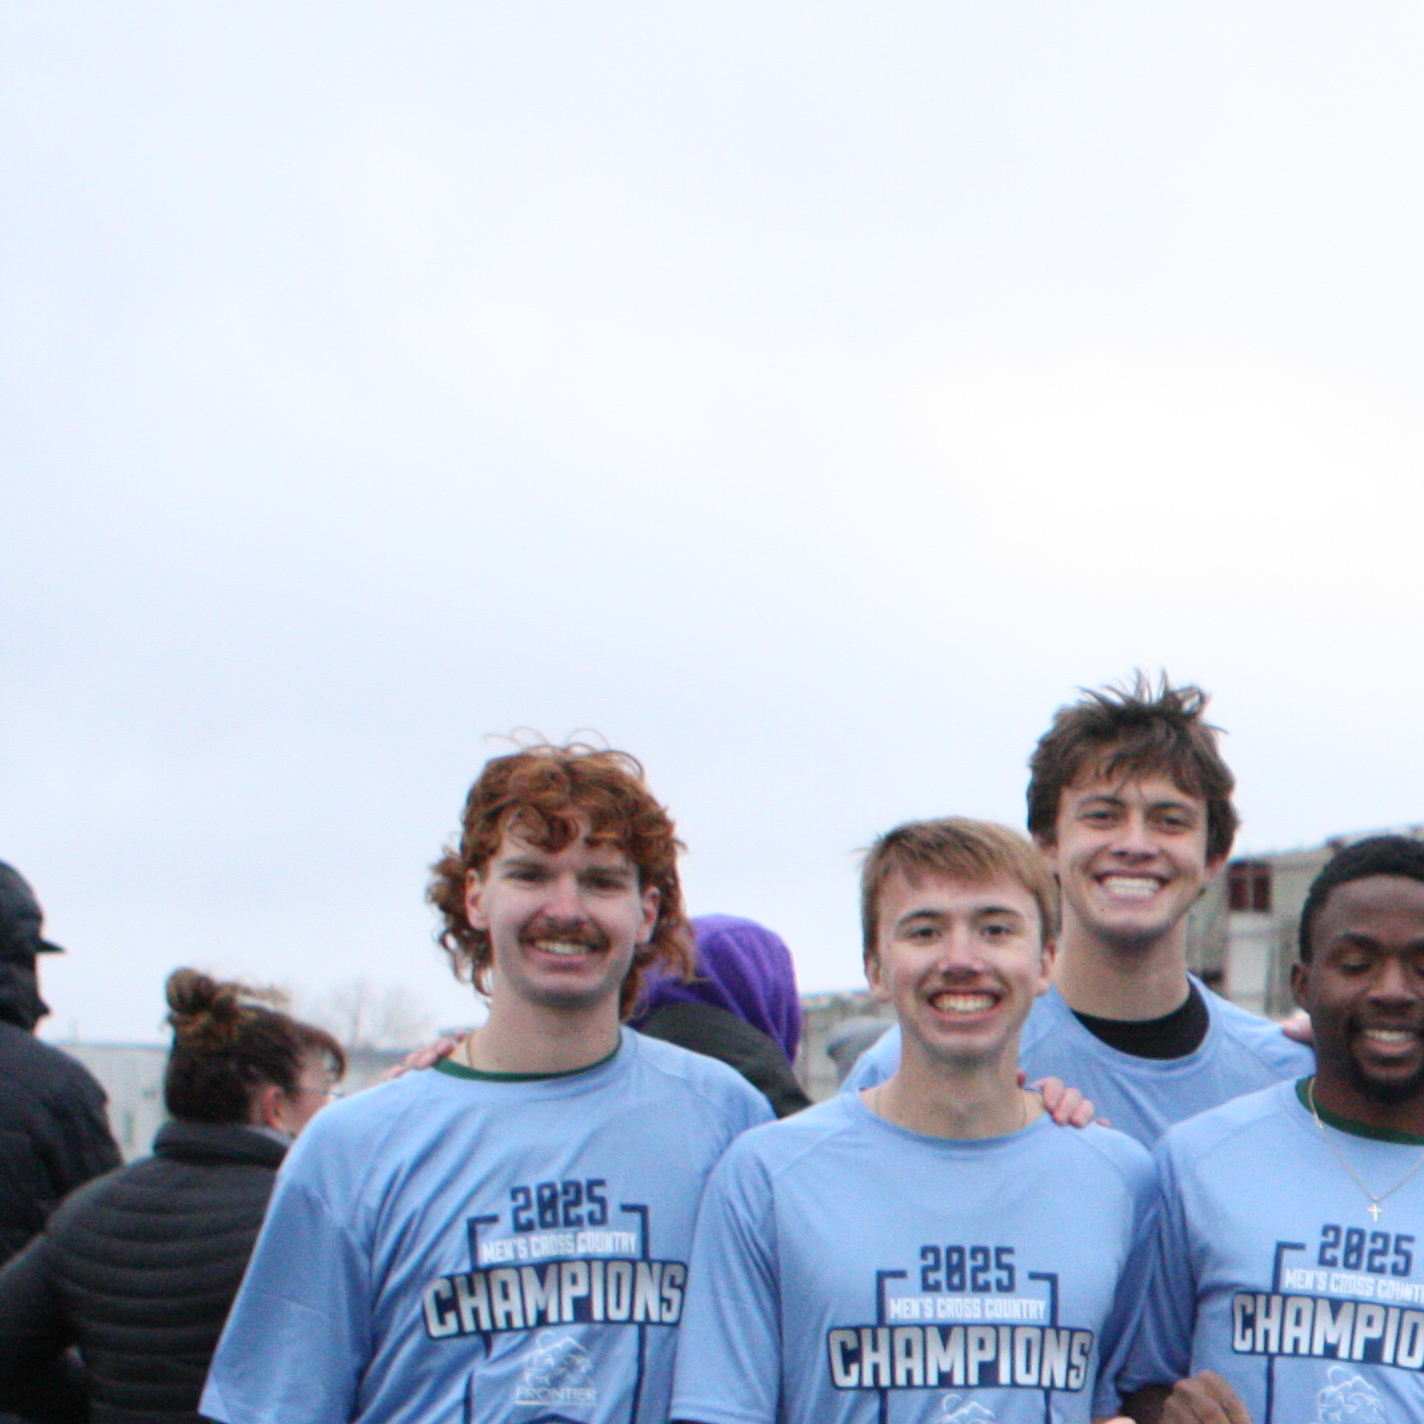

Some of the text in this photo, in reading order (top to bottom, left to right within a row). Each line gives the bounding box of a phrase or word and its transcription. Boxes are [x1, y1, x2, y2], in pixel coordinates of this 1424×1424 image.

[510, 1178, 608, 1232] 2025
[529, 1234, 574, 1258] CROSS
[576, 1231, 637, 1254] COUNTRY
[920, 1245, 1016, 1293] 2025
[1318, 1223, 1415, 1277] 2025
[424, 1261, 686, 1339] CHAMPIONS
[936, 1299, 981, 1320] CROSS
[984, 1299, 1047, 1321] COUNTRY
[1330, 1273, 1374, 1297] CROSS
[828, 1325, 1094, 1391] CHAMPIONS
